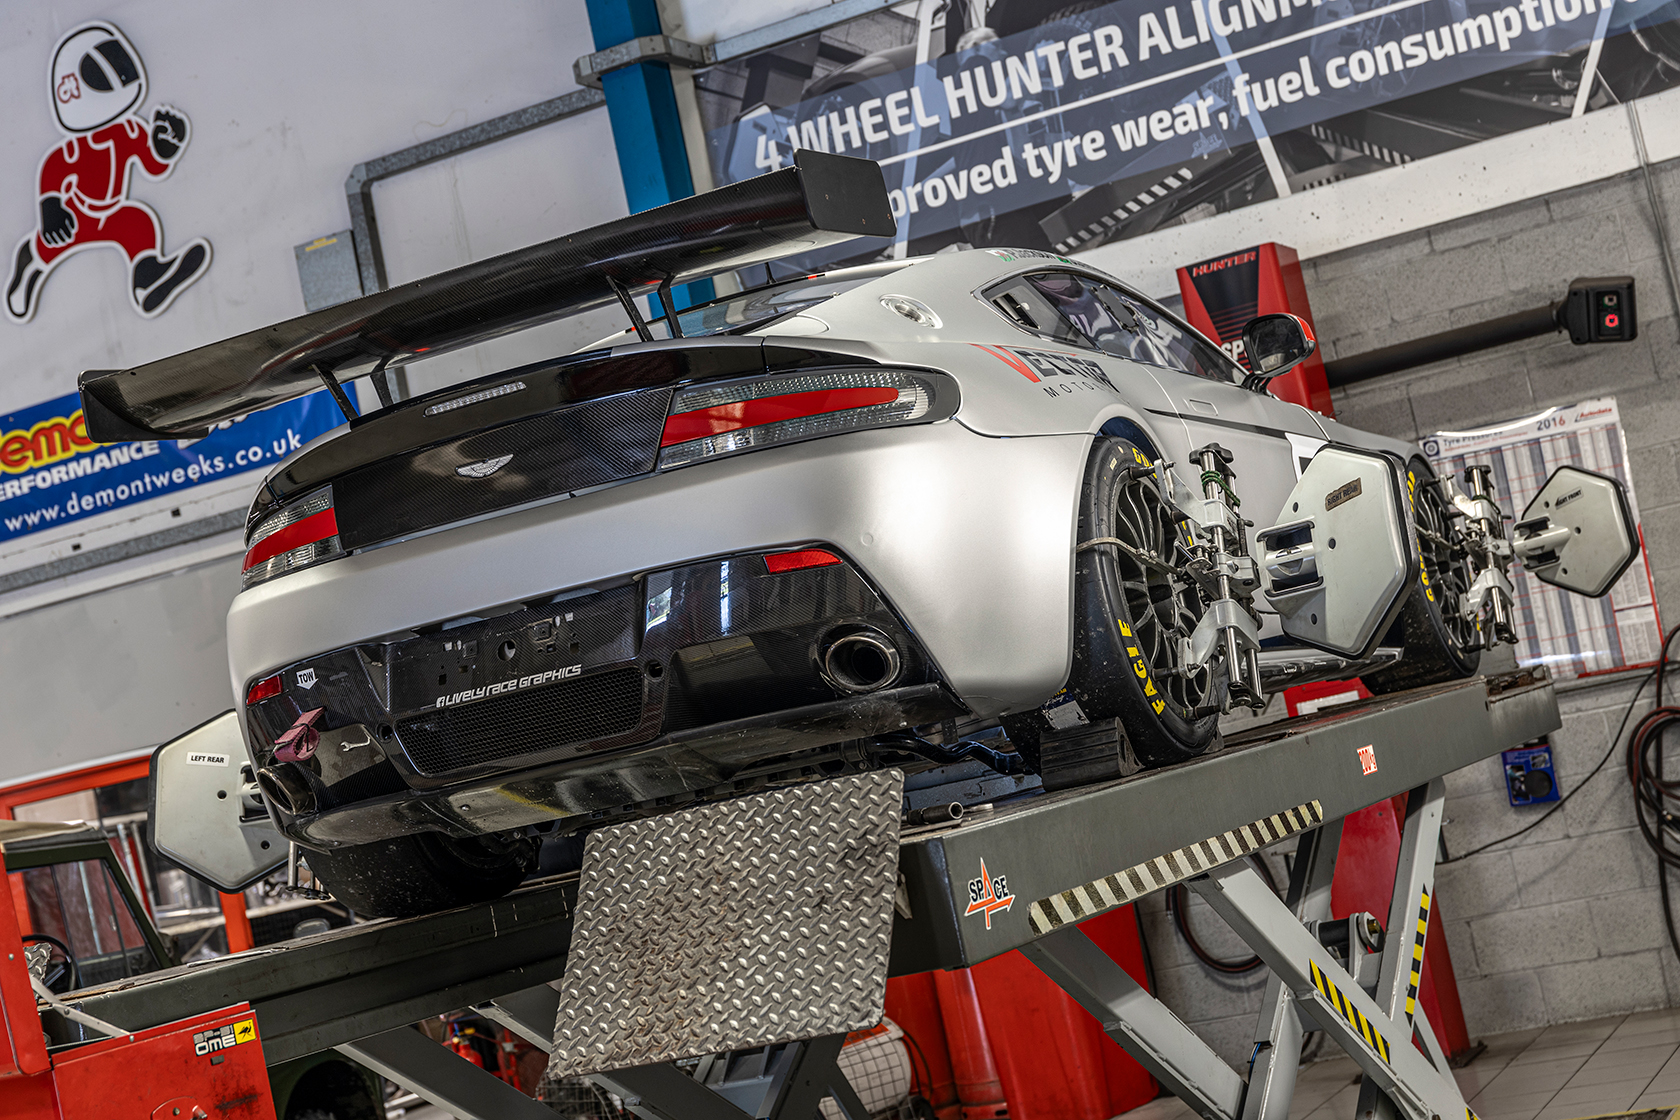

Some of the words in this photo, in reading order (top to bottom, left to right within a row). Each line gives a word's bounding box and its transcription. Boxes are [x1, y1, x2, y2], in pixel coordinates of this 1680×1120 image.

[754, 133, 784, 171] 4
[786, 85, 940, 154] WHEEL
[942, 24, 1130, 119] HUNTER
[1021, 130, 1107, 184] tyre
[1111, 94, 1230, 152] wear,
[1232, 55, 1321, 117] fuel
[1192, 250, 1258, 278] HUNTER
[1536, 417, 1566, 432] 2016
[4, 428, 302, 532] www.demontweeks.co.uk
[299, 671, 314, 684] TOW
[1117, 618, 1166, 715] EAGLE
[207, 756, 225, 764] REAR
[968, 868, 1010, 903] SPACE
[195, 1033, 236, 1056] OME
